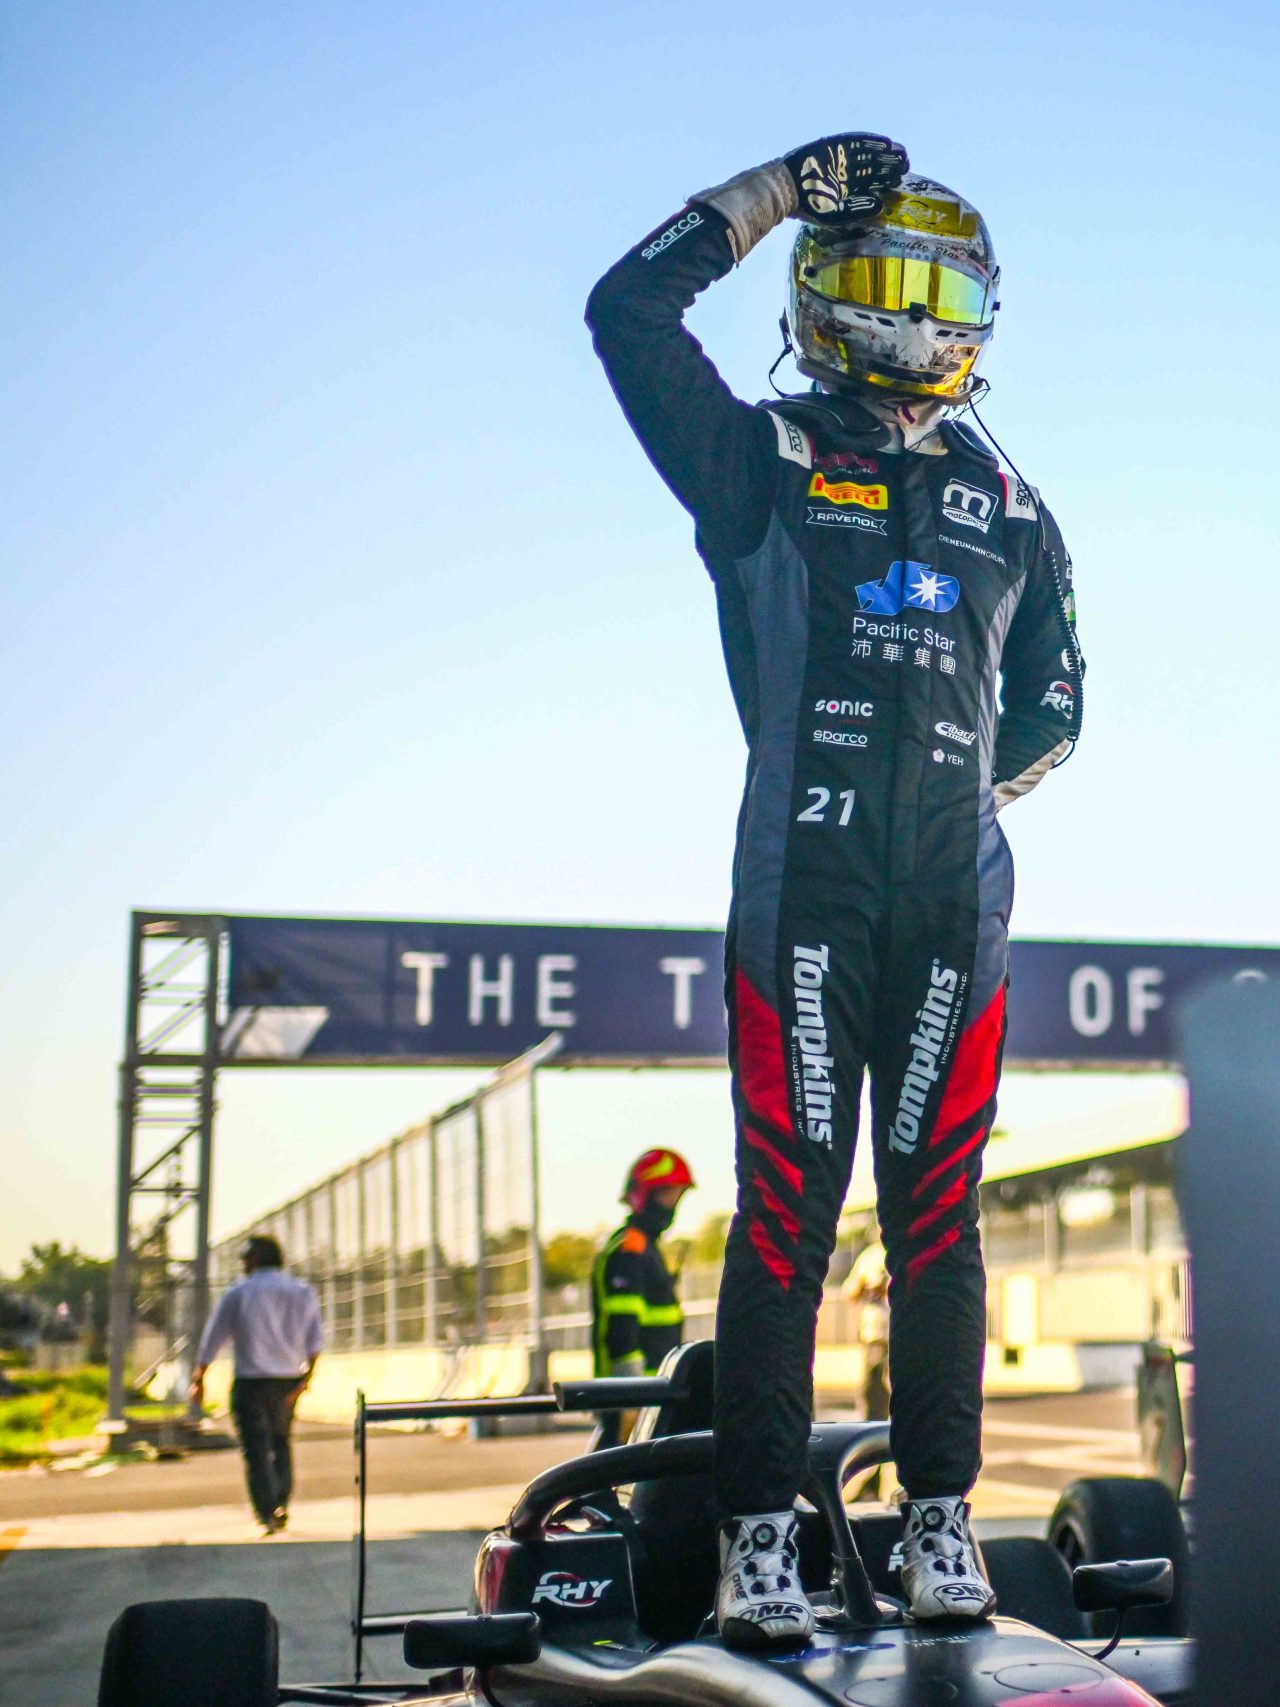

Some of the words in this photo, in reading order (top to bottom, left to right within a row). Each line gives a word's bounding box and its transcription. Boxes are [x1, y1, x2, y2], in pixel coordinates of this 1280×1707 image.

[641, 212, 704, 260] sparco
[881, 237, 928, 253] Pacific
[934, 245, 960, 261] Star
[817, 513, 879, 529] RAVENOL
[853, 617, 919, 641] Pacific
[924, 628, 956, 652] Star
[813, 730, 868, 747] sparco
[935, 722, 977, 742] Eibach
[947, 754, 964, 766] YEH
[797, 786, 856, 826] 21
[402, 952, 576, 1028] THE
[1069, 965, 1165, 1037] OF
[958, 972, 968, 994] INC.
[531, 1573, 613, 1606] RHY
